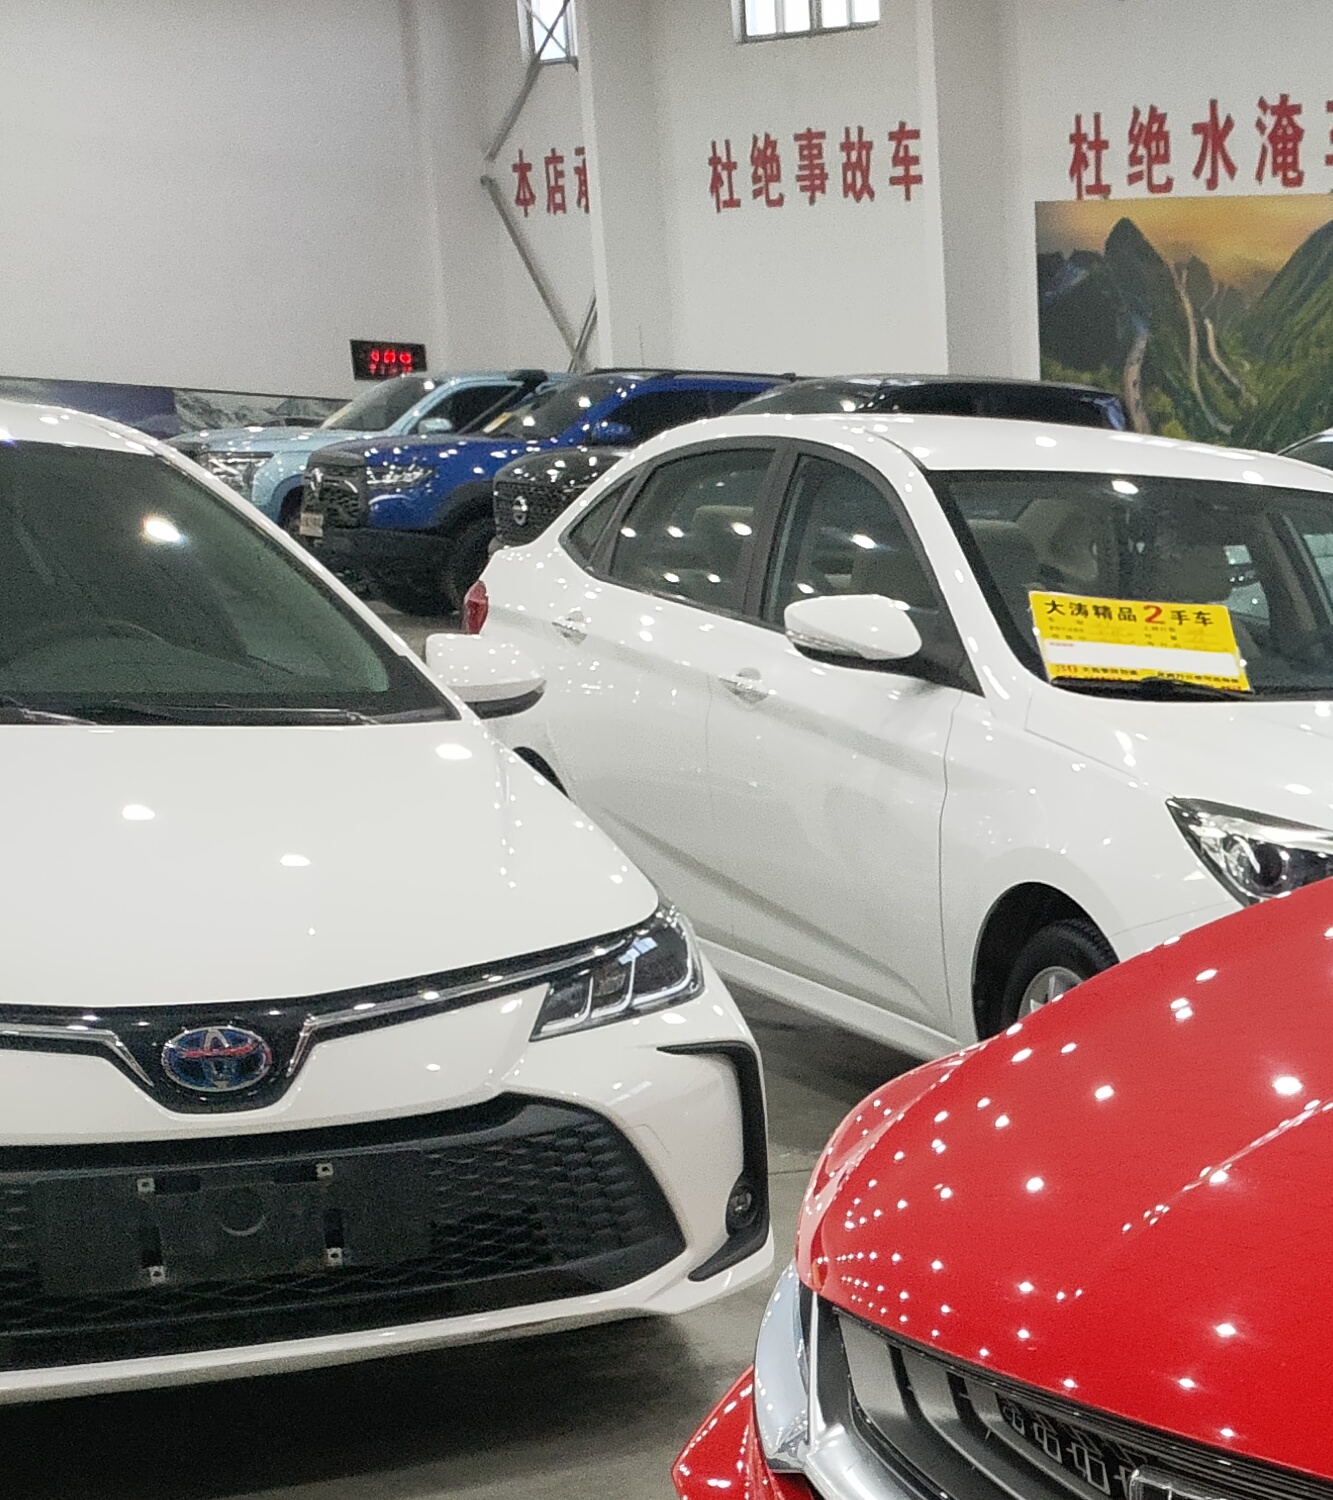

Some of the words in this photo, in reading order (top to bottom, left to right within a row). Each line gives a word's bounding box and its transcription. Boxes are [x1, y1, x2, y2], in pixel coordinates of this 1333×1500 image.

[708, 121, 923, 213] 杜绝事故车
[1044, 600, 1214, 627] 大涛精品2手车
